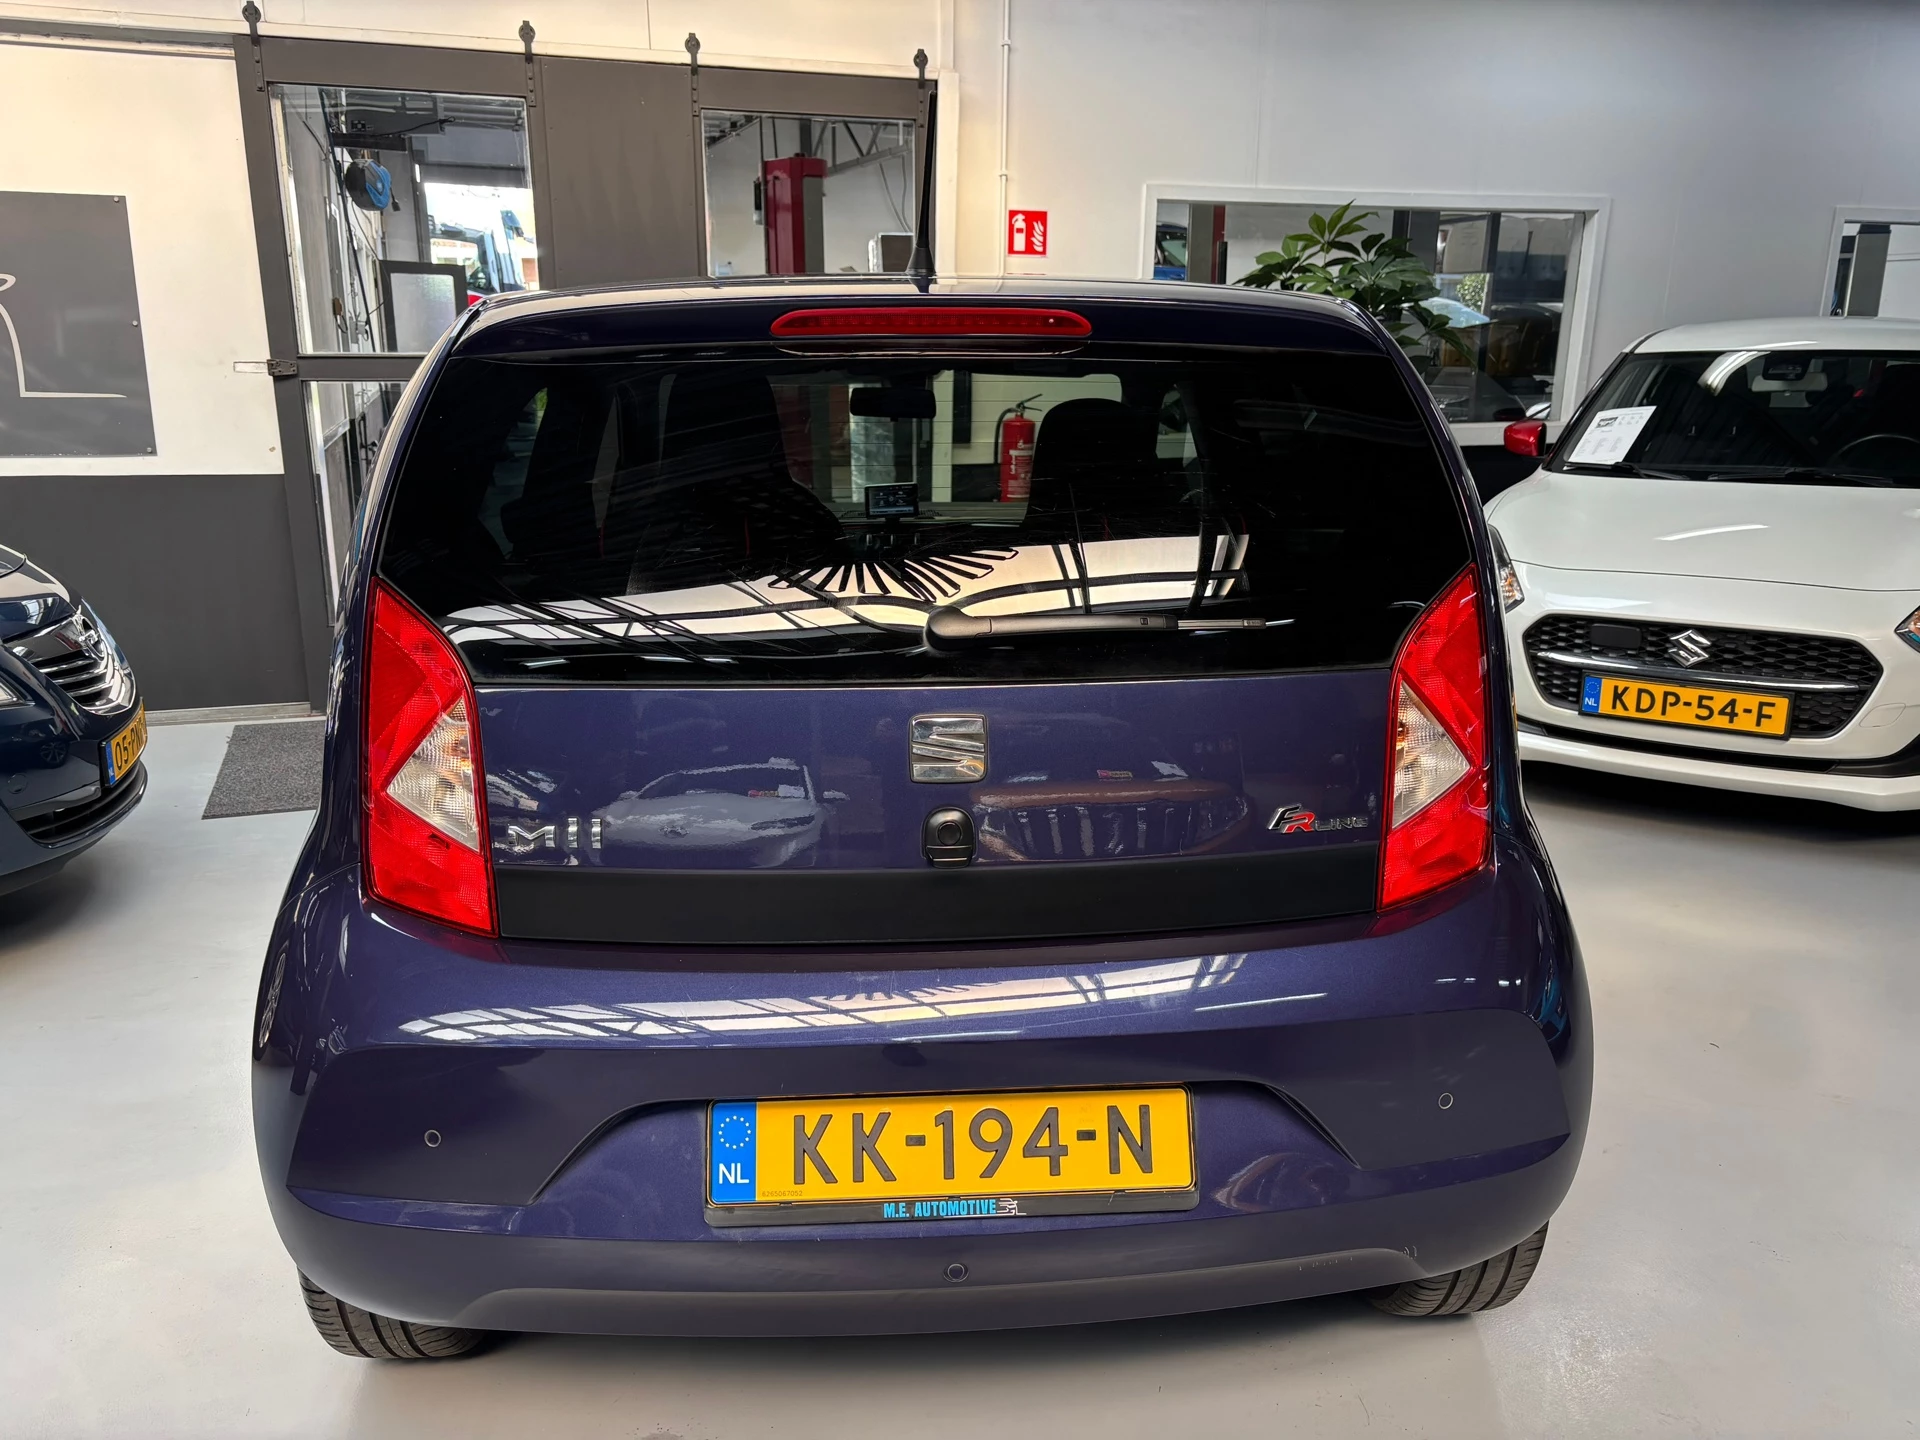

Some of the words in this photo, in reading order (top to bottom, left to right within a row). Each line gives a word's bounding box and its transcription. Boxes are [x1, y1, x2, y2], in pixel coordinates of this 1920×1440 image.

[1584, 697, 1598, 707] NL
[1611, 684, 1776, 727] KDP-54-F
[793, 1105, 1153, 1185] KK-194-N
[718, 1162, 750, 1184] NL
[883, 1202, 910, 1219] M.E.
[914, 1199, 997, 1217] AUTOMOTIVE
